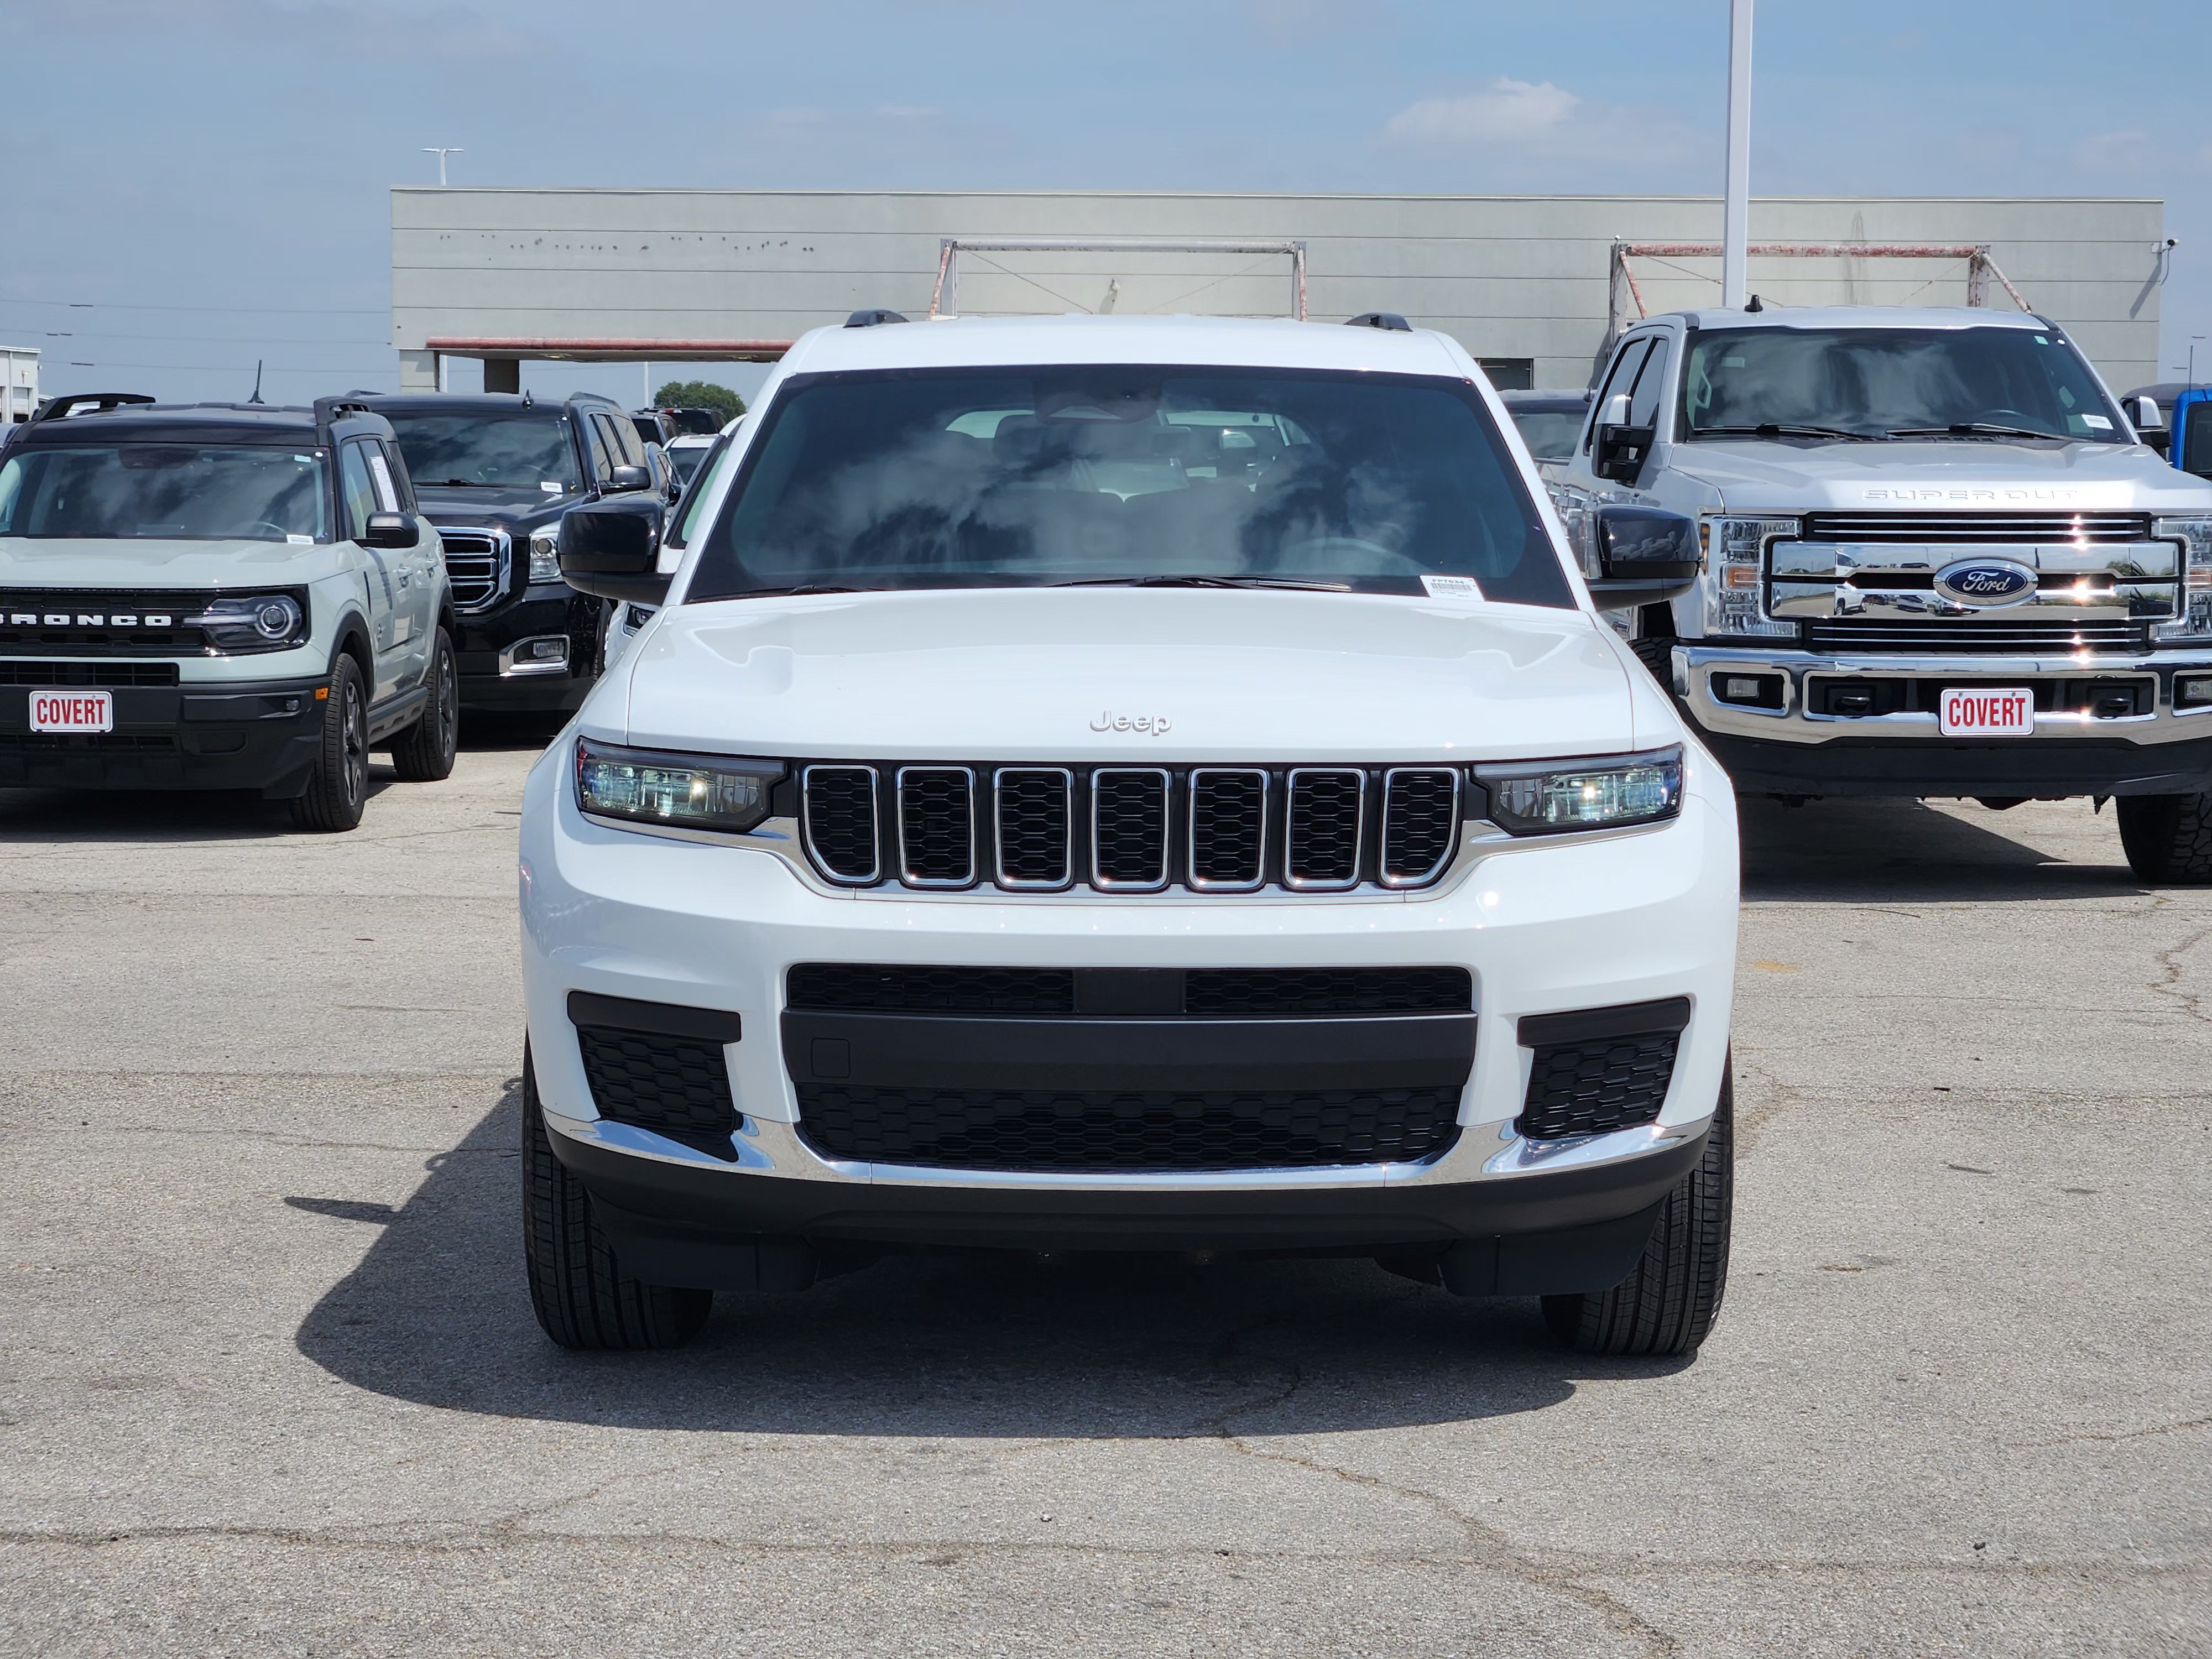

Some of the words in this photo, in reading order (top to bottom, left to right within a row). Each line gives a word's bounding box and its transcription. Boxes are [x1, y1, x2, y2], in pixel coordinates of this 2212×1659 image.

[1864, 490, 1995, 500] SUPER
[1963, 571, 2011, 591] Ford
[0, 614, 171, 626] RONCO
[36, 698, 105, 724] COVERT
[1949, 697, 2026, 727] COVERT
[1090, 710, 1172, 736] Jeep
